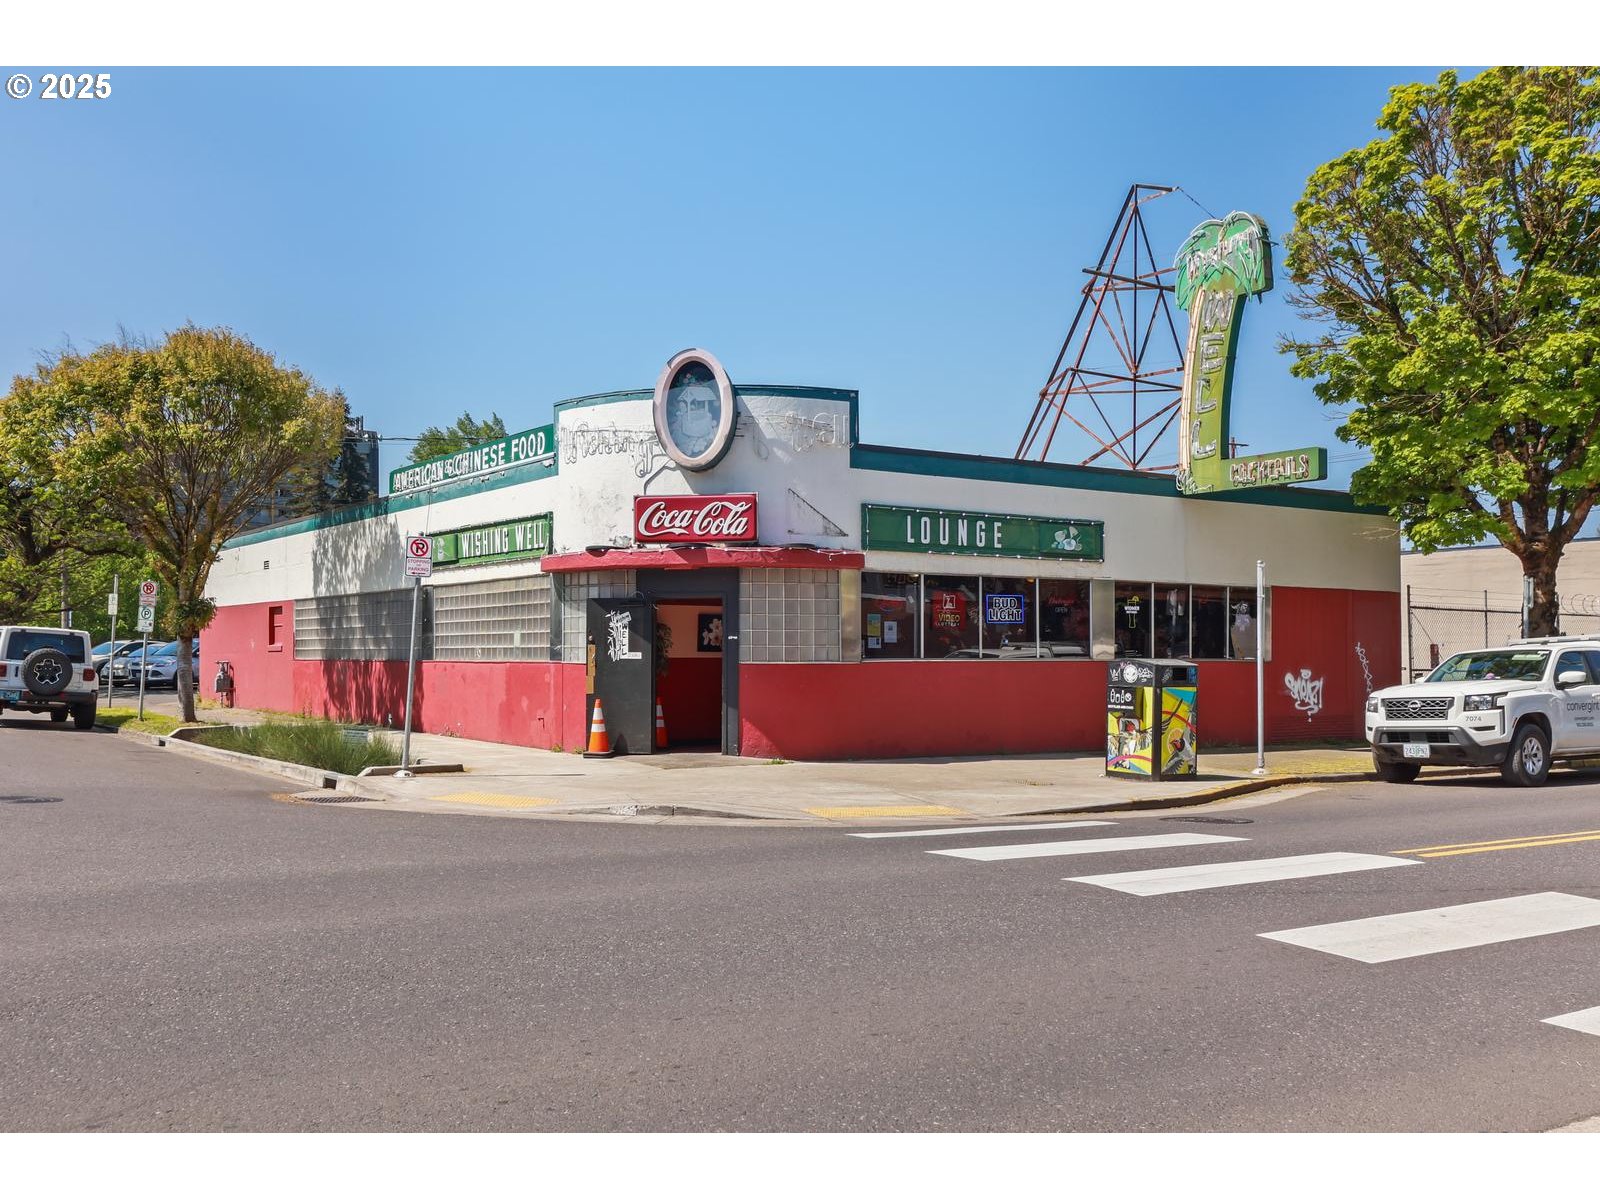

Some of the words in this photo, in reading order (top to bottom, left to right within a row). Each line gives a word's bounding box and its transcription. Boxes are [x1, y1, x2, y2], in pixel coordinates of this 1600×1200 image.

[1192, 289, 1234, 460] WELL
[393, 459, 444, 492] AMERICAN
[450, 442, 507, 476] CHINESE
[511, 431, 546, 462] FOOD
[1230, 454, 1309, 485] COCKTAILS
[638, 501, 752, 536] Coca-Cola
[907, 515, 1002, 549] LOUNGE
[461, 527, 509, 558] WISHING
[515, 521, 545, 551] WELL
[938, 612, 961, 623] VIDEO
[988, 608, 1022, 621] LIGHT
[993, 597, 1017, 609] BUD
